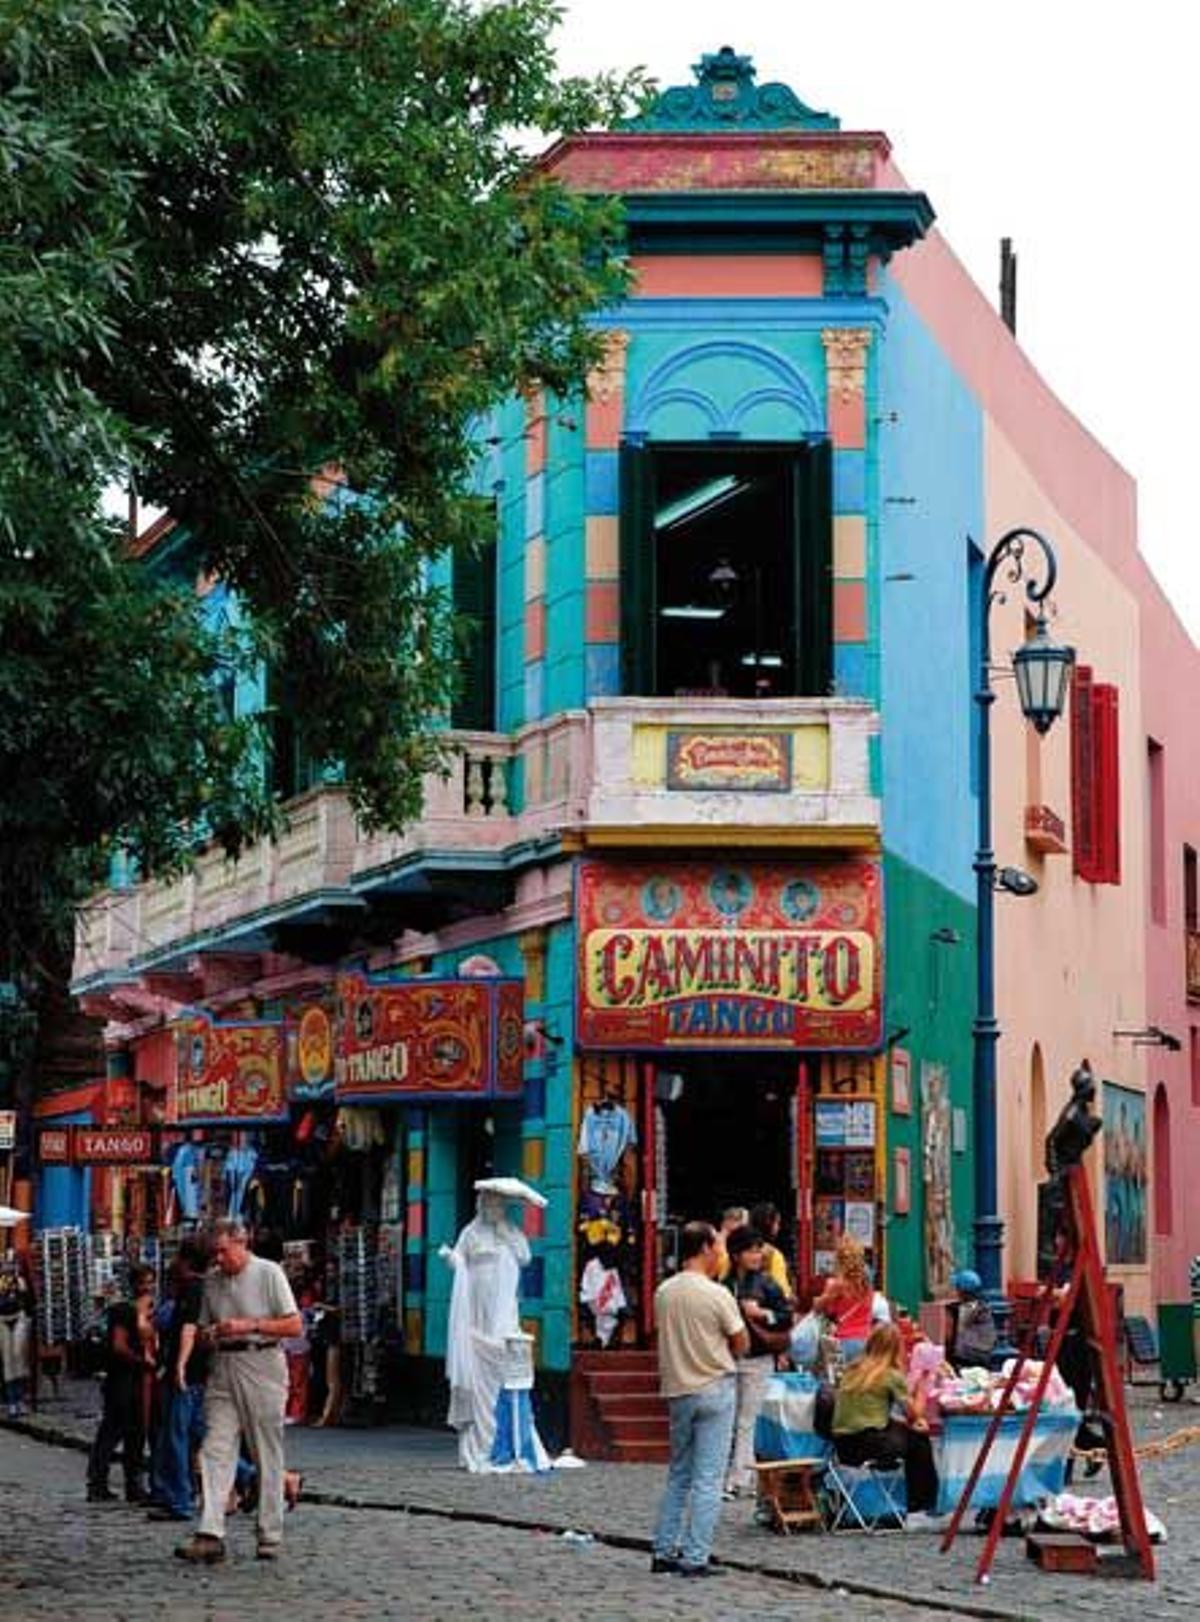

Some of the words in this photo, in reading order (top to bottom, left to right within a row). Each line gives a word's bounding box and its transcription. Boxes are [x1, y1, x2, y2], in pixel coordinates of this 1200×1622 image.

[601, 933, 861, 1002] CAMINITO
[668, 998, 795, 1034] TANGO
[347, 1041, 408, 1082] TANGO
[84, 1136, 144, 1153] TANGO
